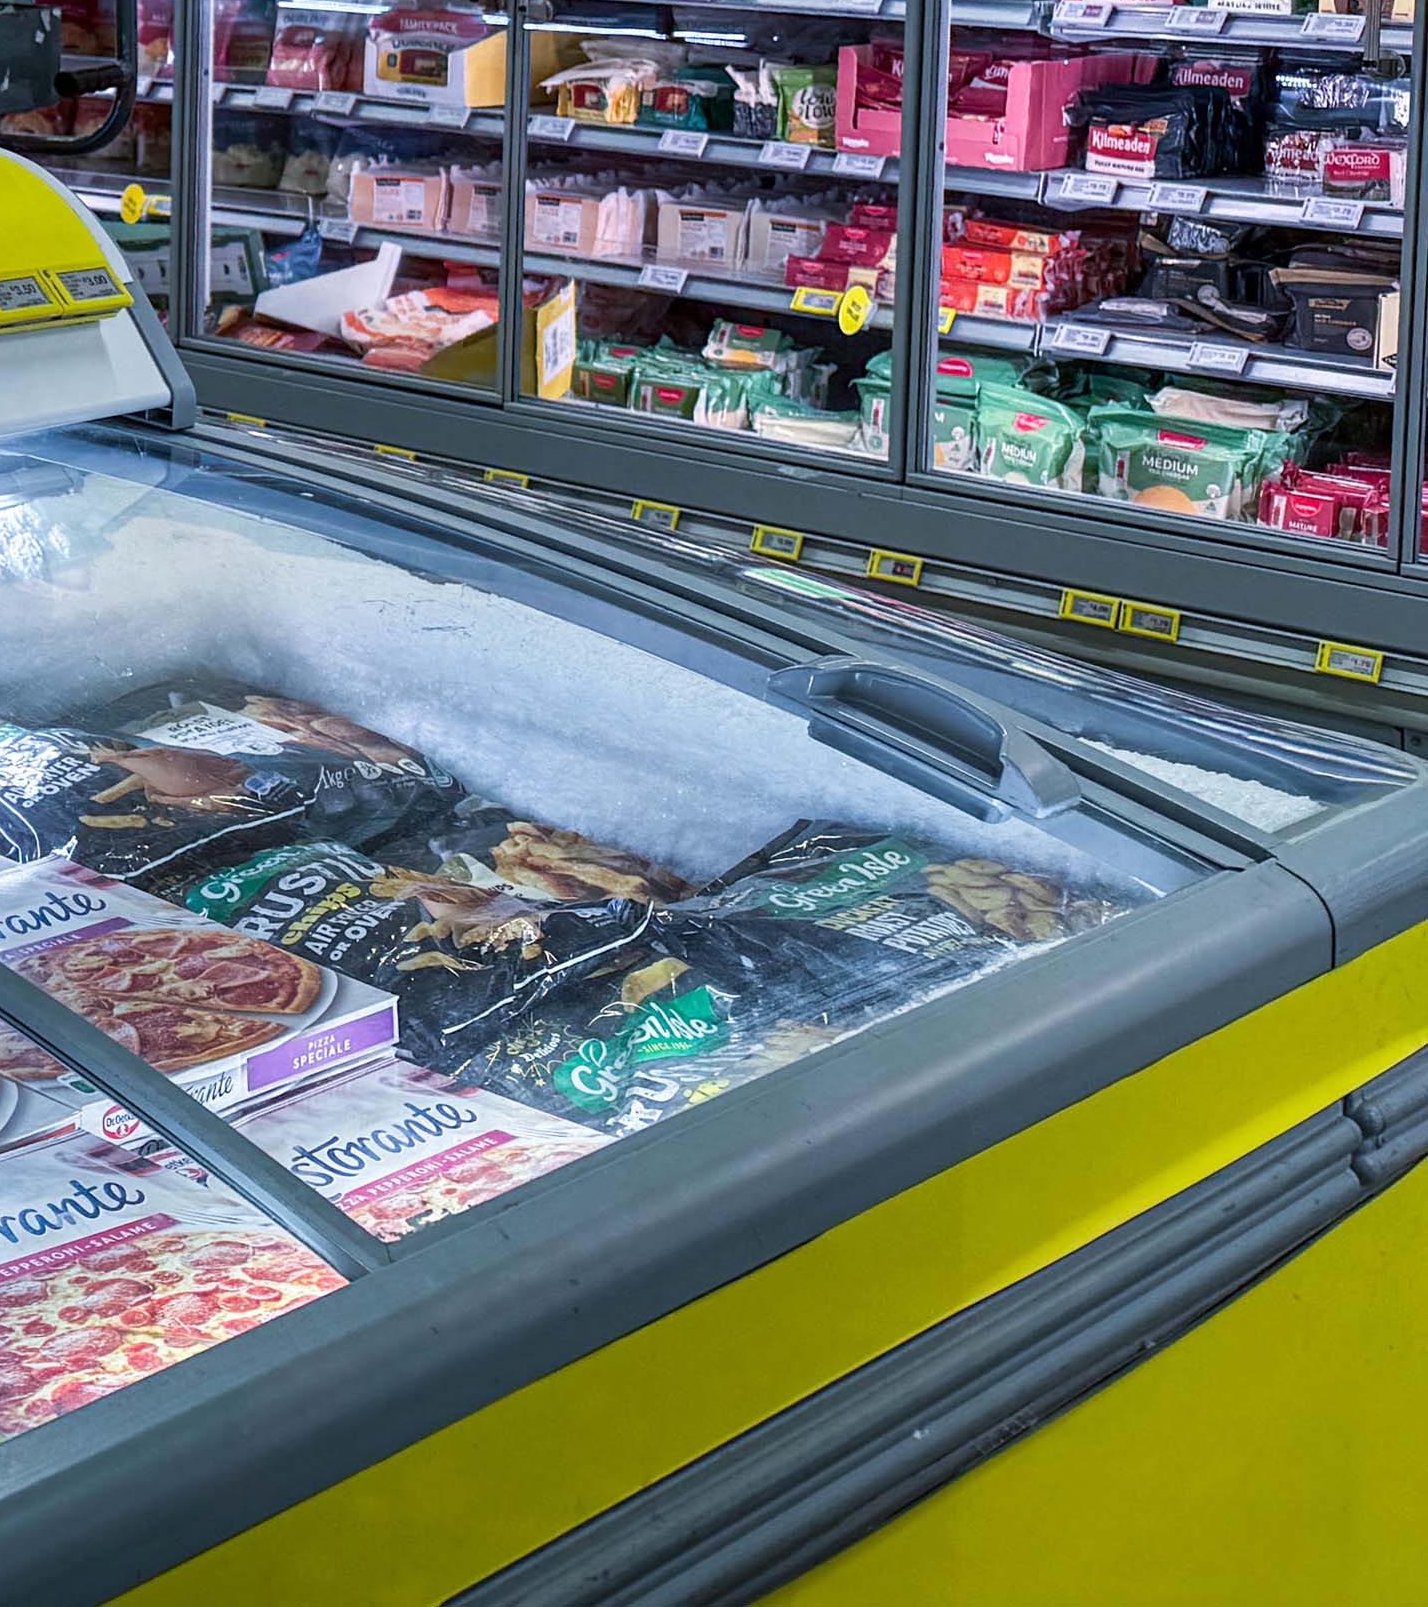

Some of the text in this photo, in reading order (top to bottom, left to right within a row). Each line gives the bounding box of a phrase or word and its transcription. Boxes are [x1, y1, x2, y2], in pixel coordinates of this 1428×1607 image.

[1175, 67, 1244, 90] Kilmeaden
[1091, 131, 1151, 155] Kilmeaden
[1002, 443, 1037, 461] MEDIUM
[1142, 455, 1199, 477] MEDIUM
[1288, 521, 1318, 534] MATURE
[769, 847, 913, 911] Green Isle
[292, 1039, 353, 1071] SPECIALE
[307, 1035, 337, 1052] PIZZA
[289, 1099, 478, 1190] storante
